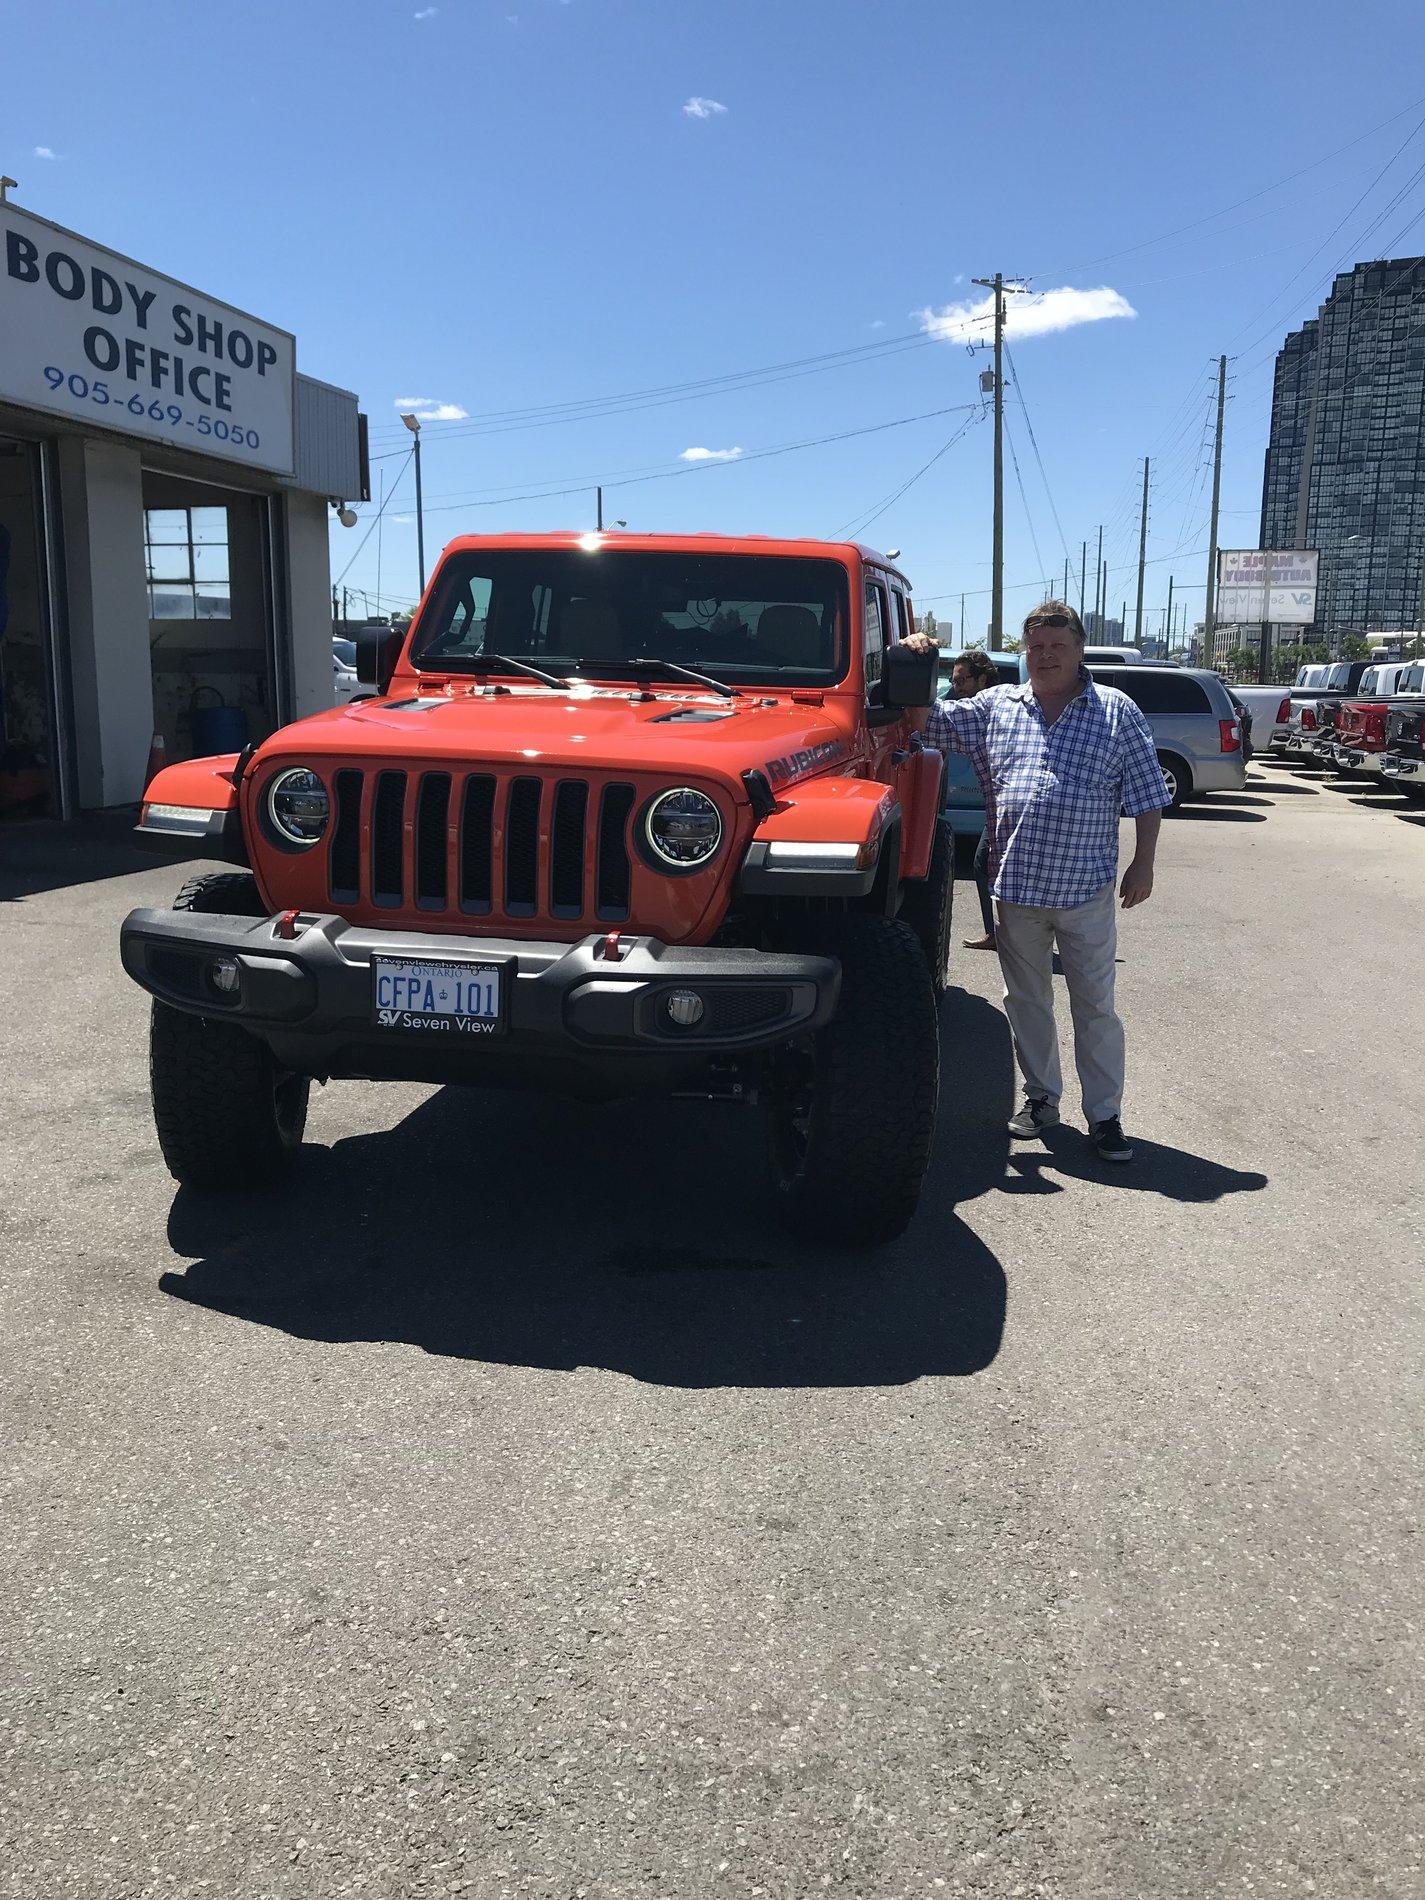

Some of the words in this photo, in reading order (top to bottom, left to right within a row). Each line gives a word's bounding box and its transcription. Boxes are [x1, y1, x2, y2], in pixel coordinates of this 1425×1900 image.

[6, 230, 156, 330] BODY
[172, 304, 277, 377] SHOP
[83, 326, 232, 412] OFFICE
[43, 366, 260, 450] 905-669-5050
[765, 739, 842, 783] RUBICON
[378, 975, 436, 1012] CFPA
[454, 982, 494, 1016] 101
[402, 1012, 450, 1031] Seven
[455, 1016, 495, 1033] View
